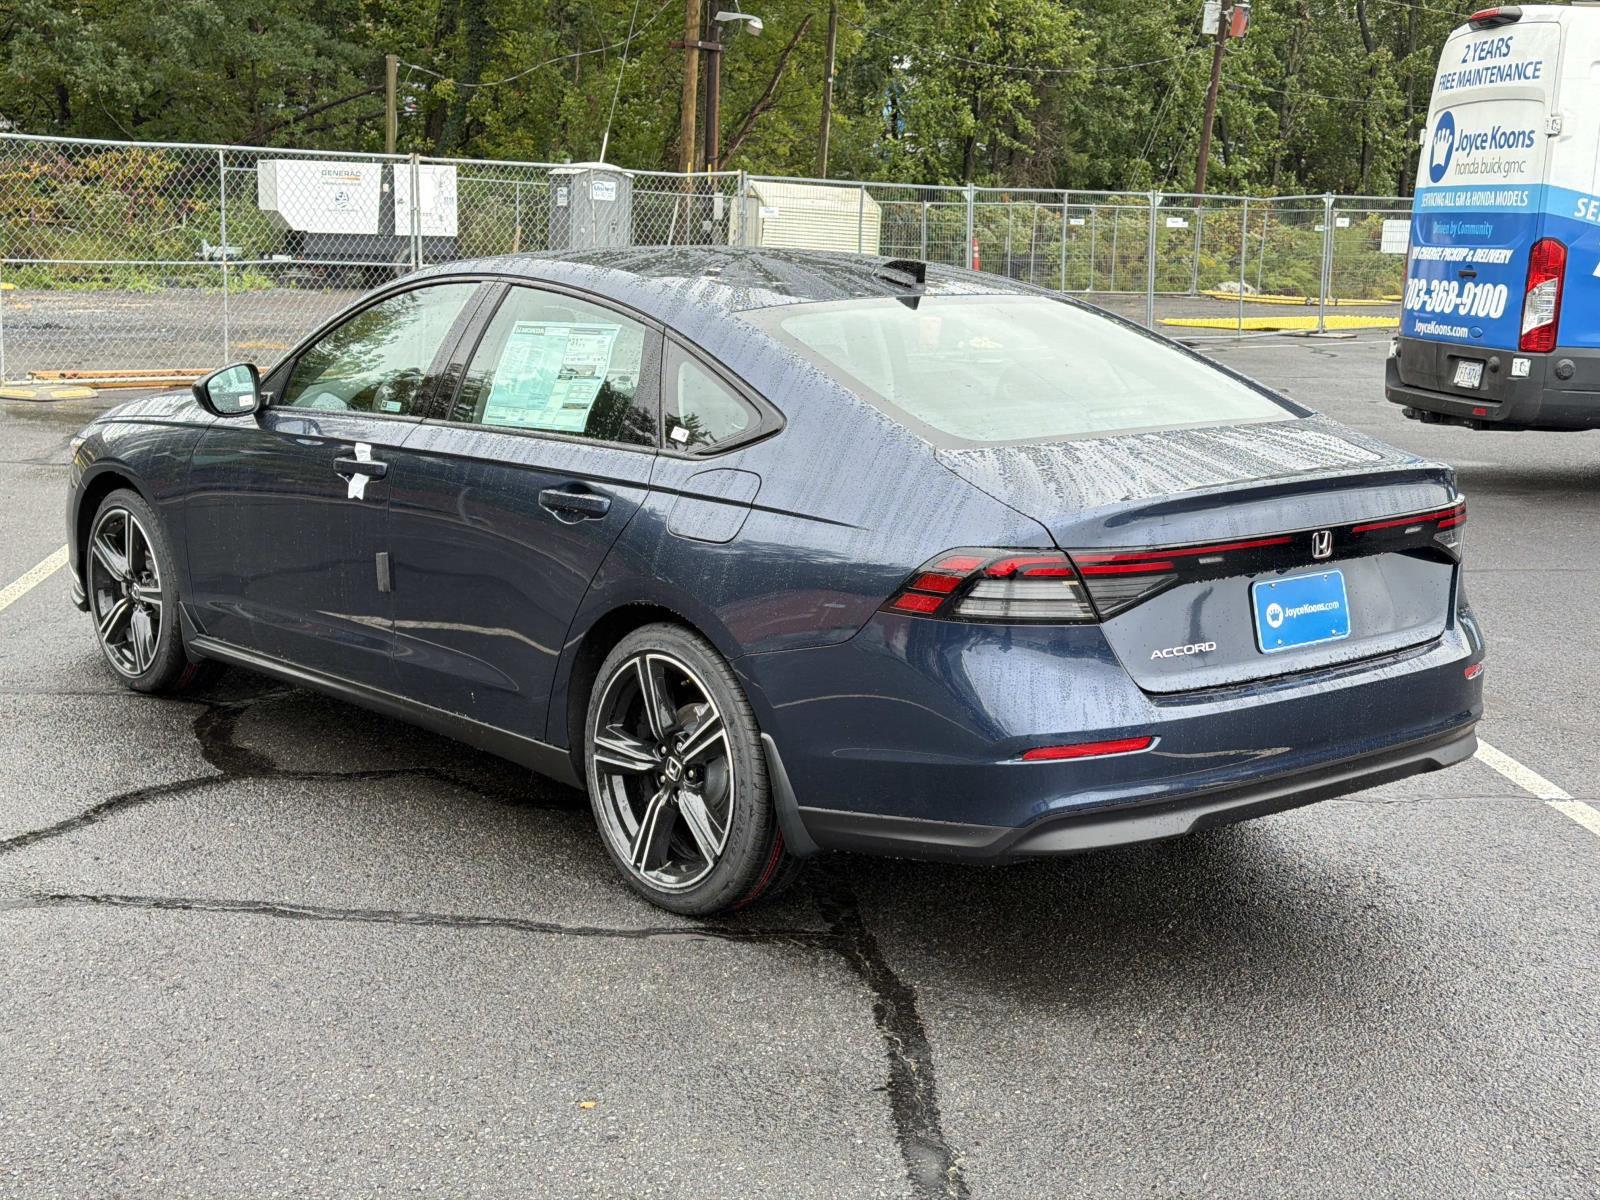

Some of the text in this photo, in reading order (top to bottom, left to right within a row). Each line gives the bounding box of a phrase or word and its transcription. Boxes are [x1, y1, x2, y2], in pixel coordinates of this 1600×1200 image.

[1461, 36, 1514, 64] 2 YEARS
[1438, 60, 1543, 92] FREE MAINTENANCE
[1455, 125, 1536, 158] Joyce Koons
[321, 169, 361, 177] GENERAC
[1455, 156, 1527, 178] honda buick gmc
[1444, 191, 1456, 207] ALL
[1456, 191, 1467, 207] GM
[1465, 191, 1472, 206] &
[1471, 191, 1497, 207] HONDA
[1496, 190, 1529, 207] MODELS
[1449, 221, 1459, 238] by
[1457, 220, 1494, 239] Community
[1440, 247, 1470, 262] PICKUP
[1465, 249, 1475, 262] &
[1472, 249, 1514, 264] DELIVERY
[1414, 319, 1469, 338] JoyceKoons.com
[1284, 600, 1340, 619] JoyceKoons.com
[1150, 641, 1217, 660] ACCORD
